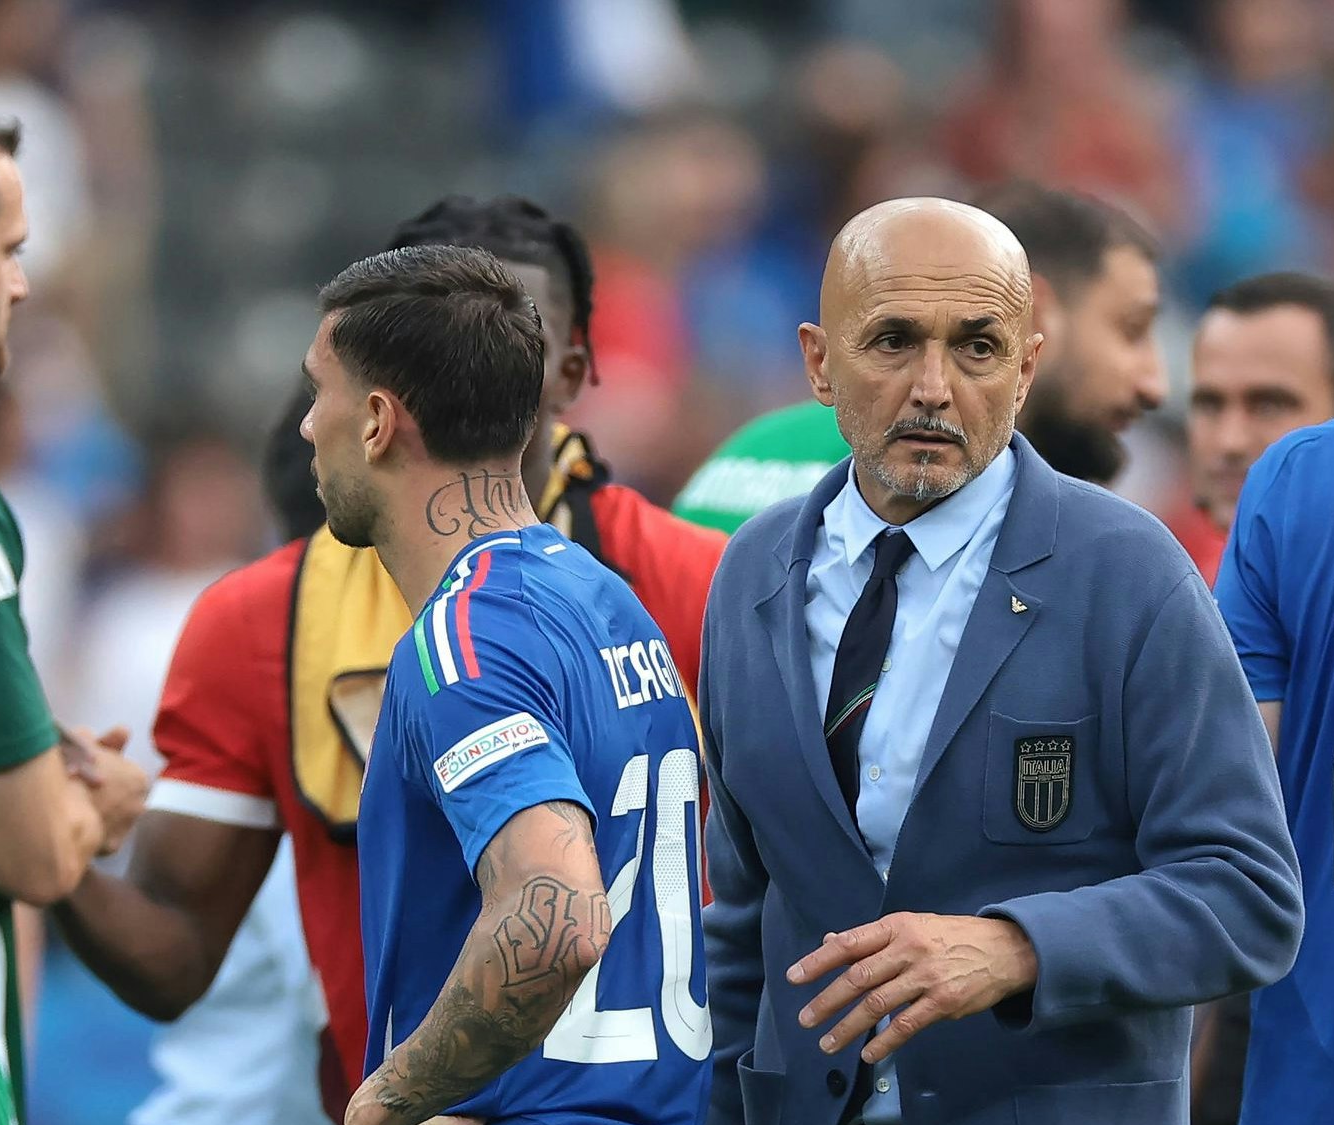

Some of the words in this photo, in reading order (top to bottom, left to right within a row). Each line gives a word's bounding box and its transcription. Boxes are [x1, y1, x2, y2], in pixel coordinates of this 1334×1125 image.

[436, 750, 458, 771] UEFA
[440, 722, 542, 782] FOUNDATION
[1023, 758, 1066, 776] ITALIA
[543, 748, 715, 1064] 20
